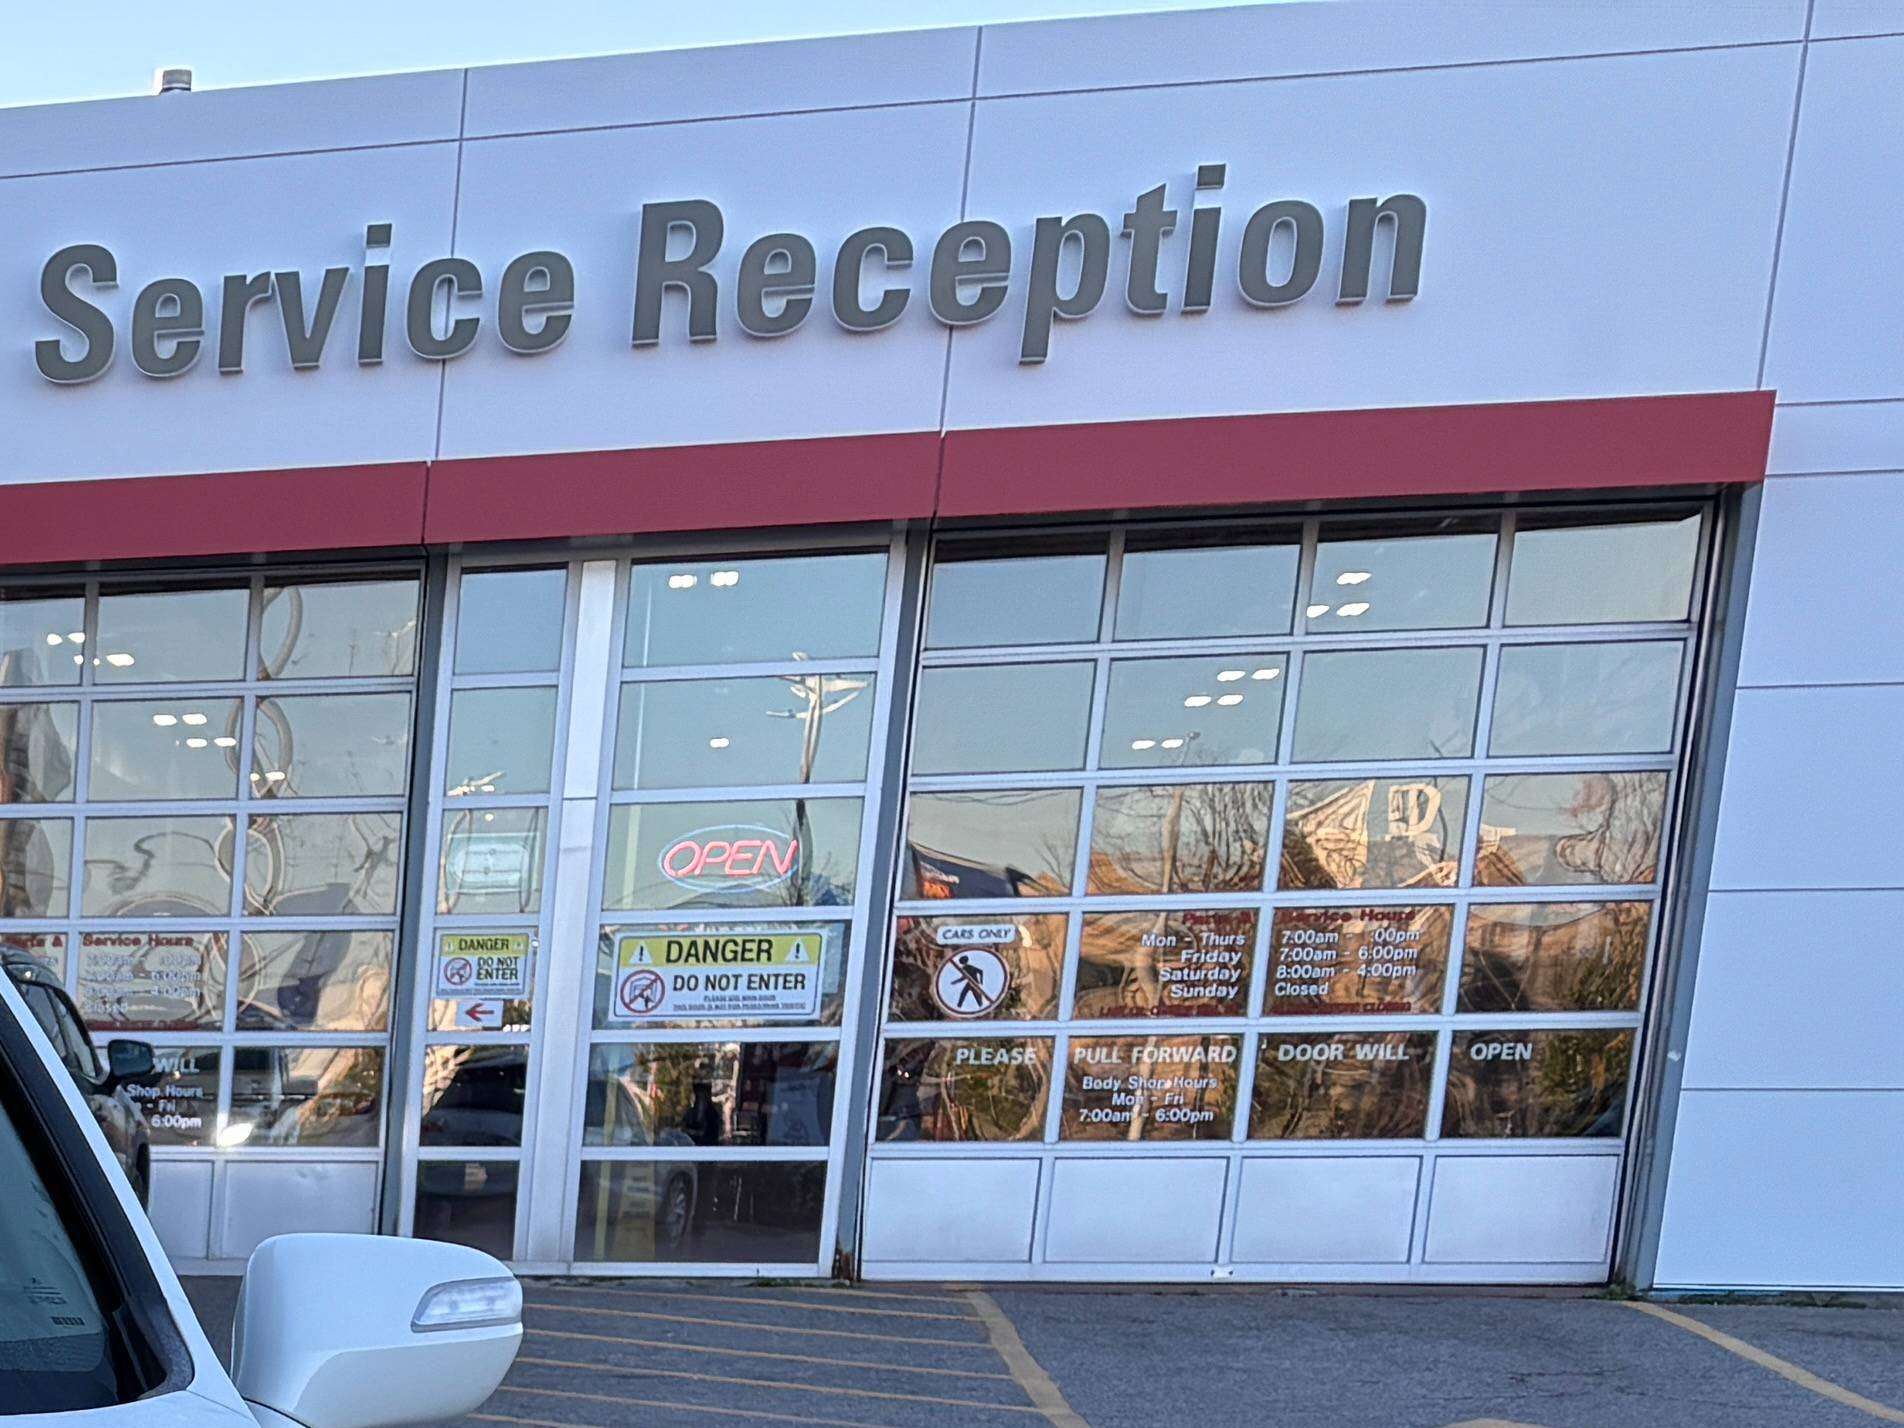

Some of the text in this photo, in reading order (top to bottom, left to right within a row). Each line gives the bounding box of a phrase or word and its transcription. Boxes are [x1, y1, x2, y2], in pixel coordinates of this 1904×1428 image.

[34, 162, 1428, 385] Service Reception
[663, 839, 798, 878] OPEN
[83, 933, 142, 947] Service
[148, 932, 194, 947] Hours
[942, 927, 1011, 940] CARS ONLY
[1141, 933, 1177, 947] Mon
[1200, 931, 1247, 946] Thurs
[1281, 929, 1339, 944] 7:00am
[458, 938, 510, 951] DANGER
[665, 938, 774, 964] DANGER
[478, 956, 520, 967] DO NOT
[1181, 949, 1243, 965] Friday
[1279, 947, 1337, 961] 7:00am
[1358, 946, 1418, 961] 6:00pm
[477, 968, 519, 981] ENTER
[1159, 966, 1243, 982] Saturday
[1276, 964, 1335, 979] 8:00am
[1357, 963, 1417, 979] 4:00pm
[673, 972, 806, 991] DO NOT ENTER
[1171, 982, 1329, 1000] Sunday Closed
[955, 1042, 1533, 1065] PLEASE PULL FORWARD DOOR WILL OPEN
[127, 1083, 204, 1100] Shop Hours
[1082, 1075, 1218, 1092] Body Shop Hours
[1112, 1092, 1144, 1106] Mon
[1165, 1092, 1184, 1105] Fri
[151, 1114, 203, 1130] 6:00pm
[1079, 1108, 1135, 1122] 7:00am
[1155, 1108, 1214, 1123] 6:00pm
